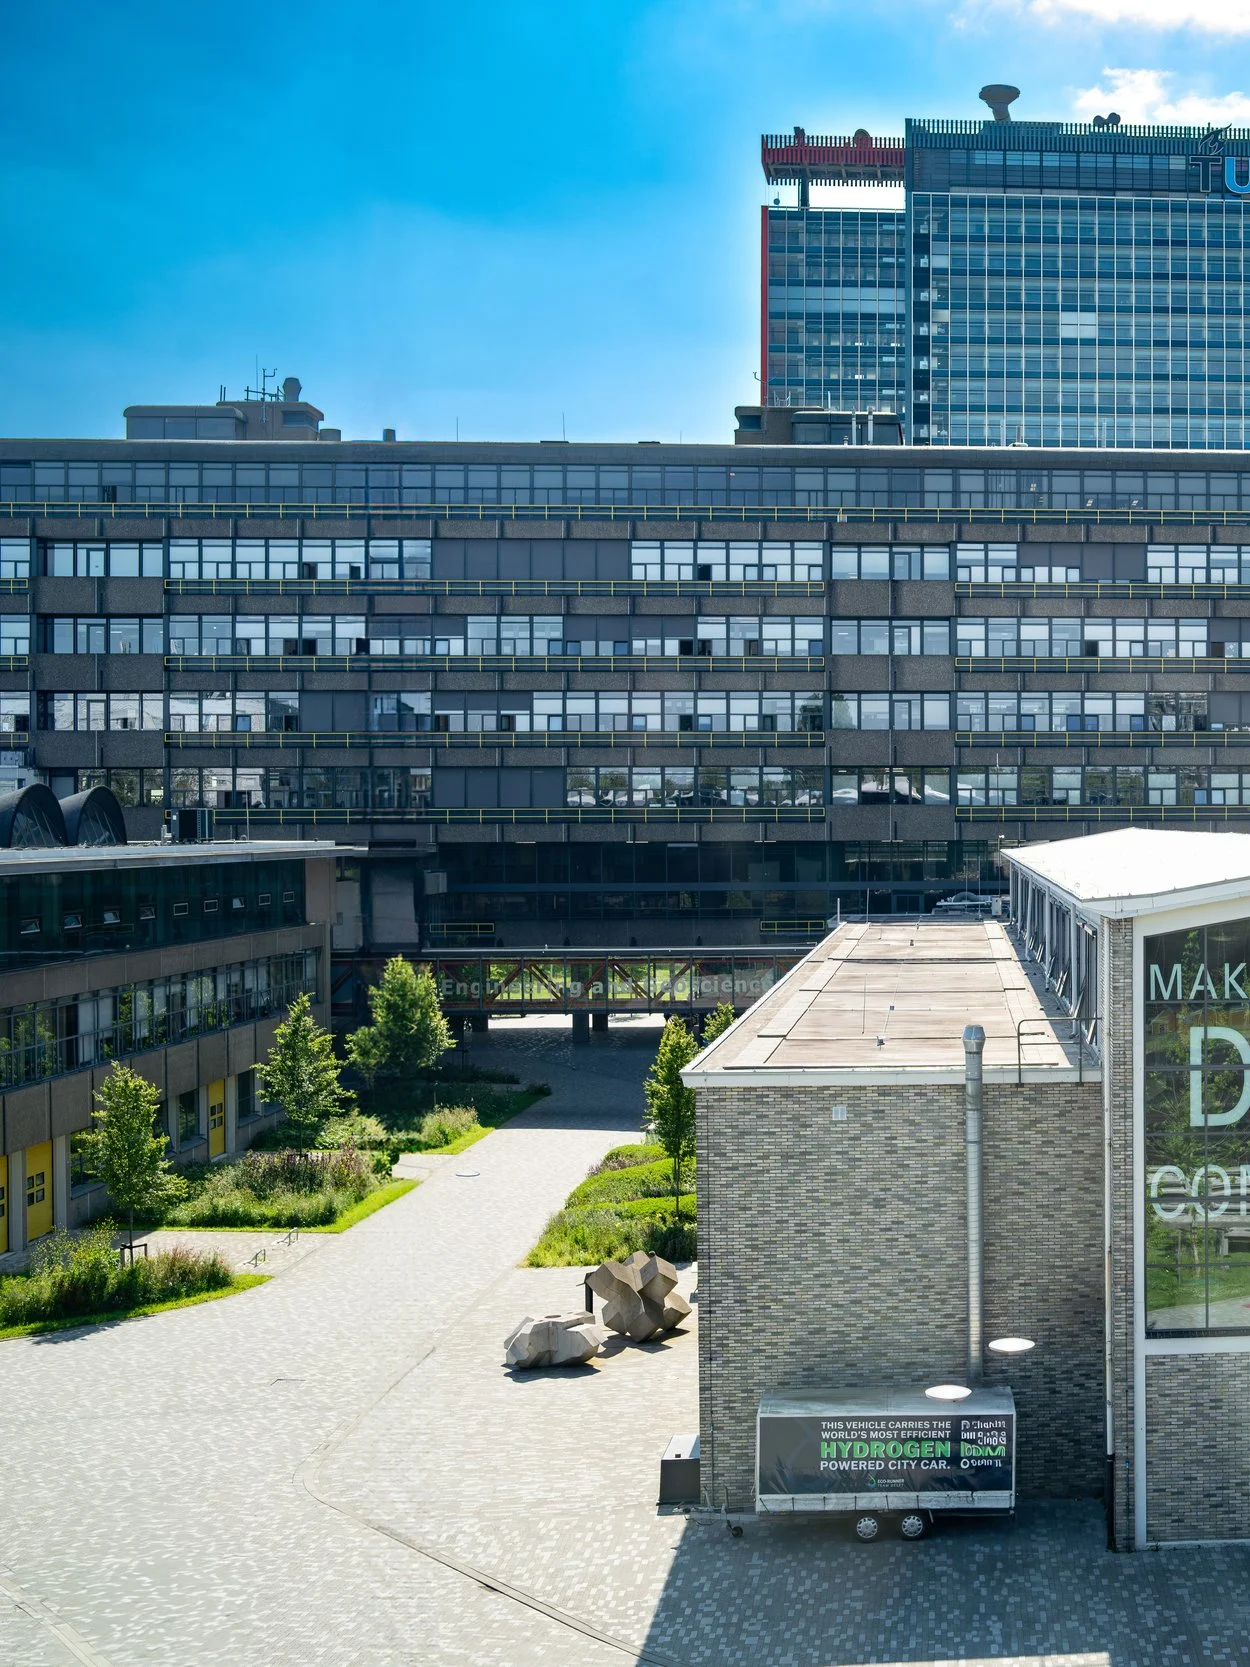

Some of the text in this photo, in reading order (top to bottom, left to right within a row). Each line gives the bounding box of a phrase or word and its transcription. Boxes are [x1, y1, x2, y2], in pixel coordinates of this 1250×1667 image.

[441, 977, 581, 998] Engineering
[591, 976, 633, 994] and
[821, 1421, 844, 1429] THIS
[845, 1421, 887, 1429] VEHICLE
[888, 1420, 930, 1429] CARRIES
[932, 1420, 951, 1428] THE
[821, 1431, 868, 1439] WORLD'S
[869, 1431, 899, 1439] MOST
[900, 1430, 951, 1439] EFFICIENT
[820, 1440, 951, 1459] HYDROGEN
[820, 1460, 885, 1471] POWERED
[887, 1460, 918, 1470] CITY
[919, 1460, 951, 1470] CAR.
